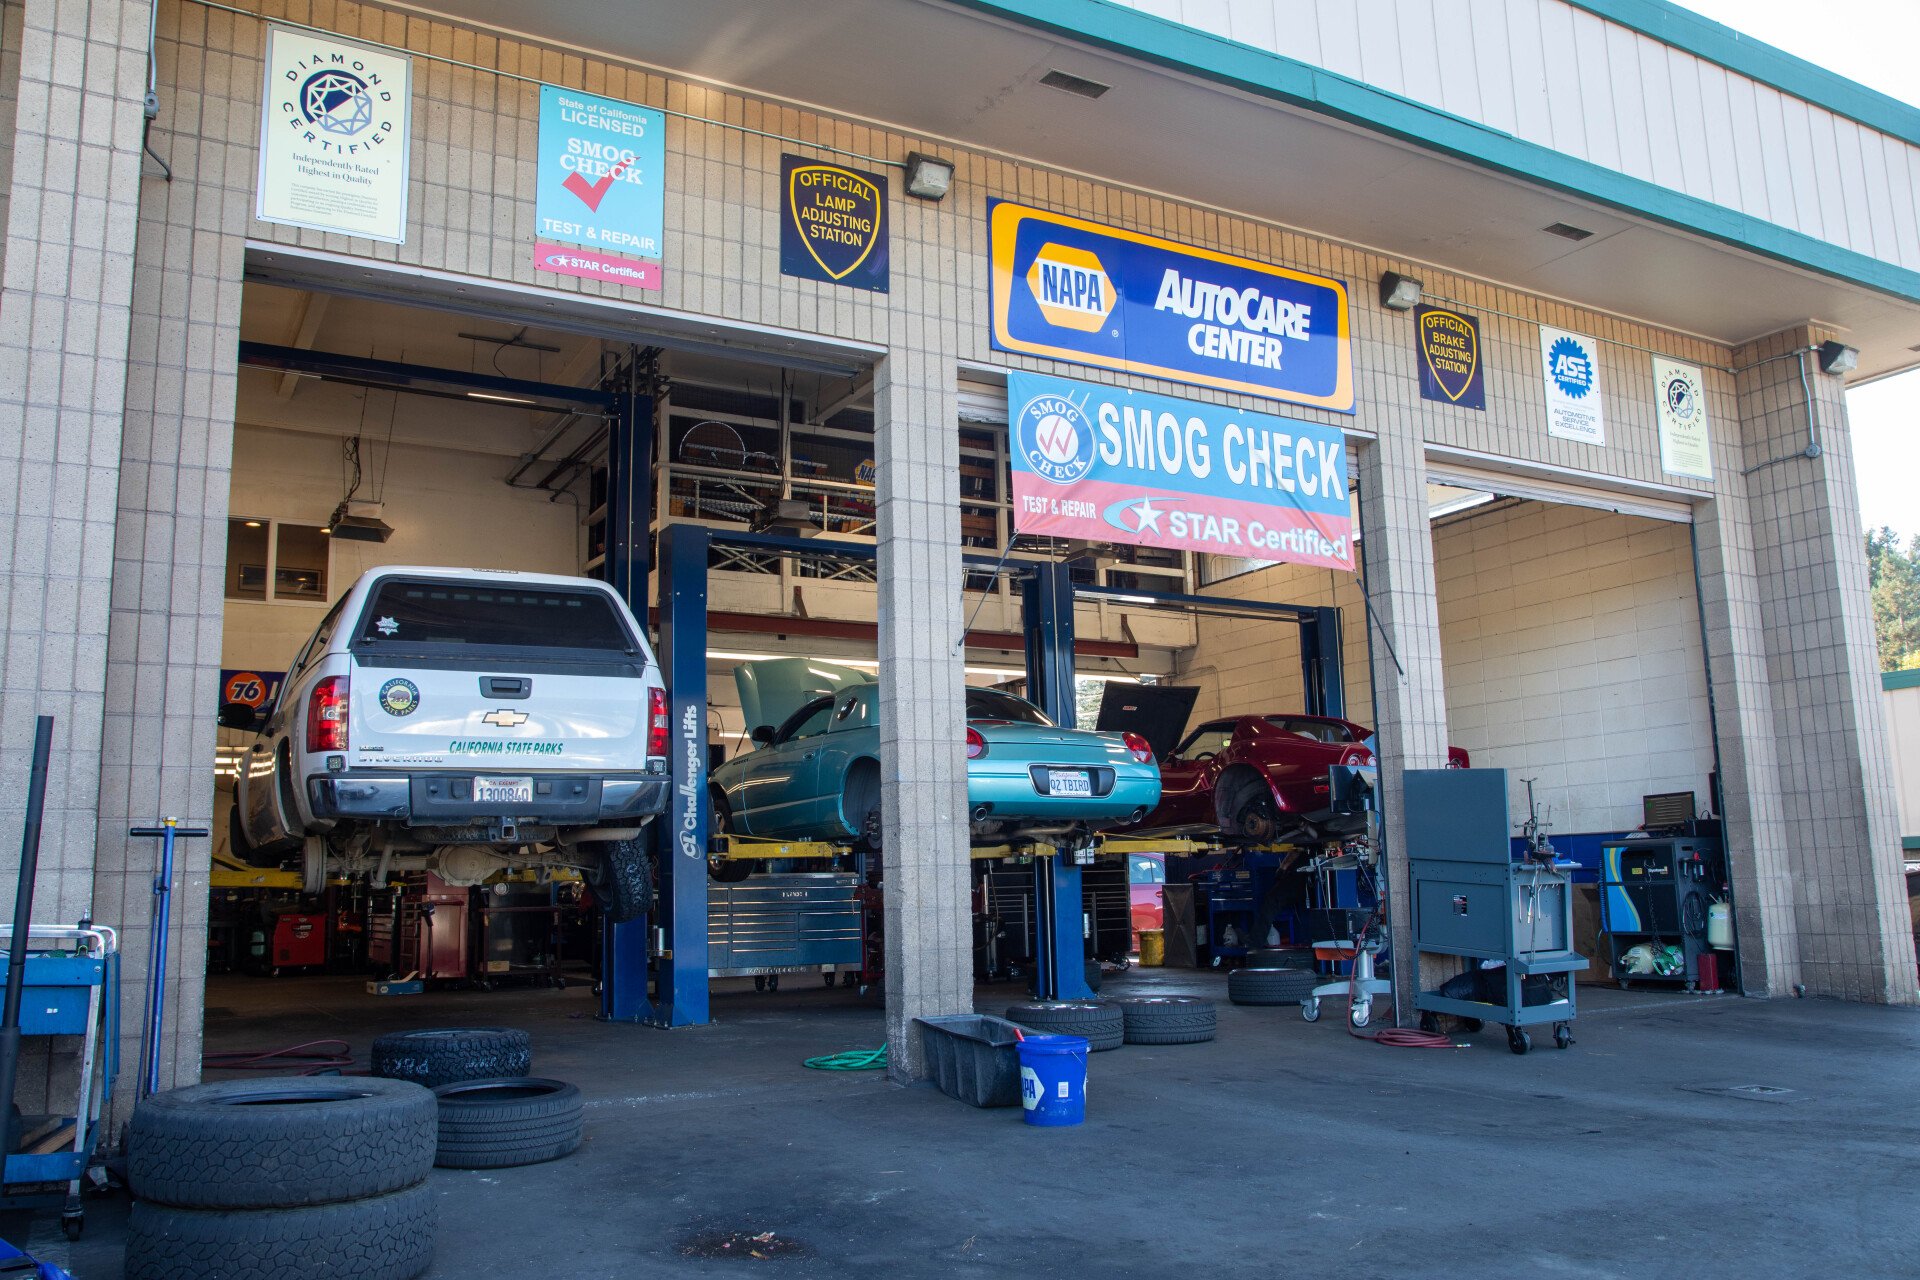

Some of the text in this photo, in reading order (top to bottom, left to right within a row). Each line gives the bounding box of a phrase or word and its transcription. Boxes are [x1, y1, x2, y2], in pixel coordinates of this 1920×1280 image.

[286, 53, 392, 102] DIAMOND
[558, 97, 648, 124] State of California
[283, 101, 392, 155] CERTIFIED
[561, 108, 644, 138] LICENSED
[567, 137, 637, 166] SMOG
[292, 152, 379, 176] Independently Rated
[298, 165, 373, 186] Highest in Quality
[559, 153, 643, 185] CHECK
[800, 172, 871, 201] OFFICIAL
[816, 192, 856, 212] LAMP
[801, 206, 871, 233] ADJUSTING
[543, 218, 655, 251] TEST & REPAIR
[810, 224, 862, 247] STATION
[571, 258, 645, 280] STAR Certified
[1042, 263, 1102, 312] NAPA
[1426, 317, 1470, 338] OFFICIAL
[1187, 323, 1283, 371] CENTER
[1432, 331, 1466, 349] BRAKE
[1429, 343, 1472, 363] ADJUSTING
[1435, 358, 1468, 374] STATION
[1554, 353, 1587, 380] ASE
[1557, 374, 1587, 386] CERTIFIED
[1661, 368, 1699, 397] DIAMOND
[1030, 400, 1079, 422] SMOG
[1553, 408, 1596, 423] AUTOMOTIVE
[1562, 415, 1589, 427] SERVICE
[1662, 400, 1702, 431] CERTIFIED
[1555, 420, 1597, 434] EXCELLENCE
[1098, 402, 1345, 501] SMOG CHECK
[1029, 450, 1087, 479] CHECK
[1022, 495, 1097, 519] TEST & REPAIR
[1169, 510, 1347, 561] STAR Certified
[231, 681, 261, 701] 76
[382, 680, 418, 695] CALIFORNIA
[381, 698, 418, 716] STATE PARKS
[682, 704, 697, 738] Lifts
[449, 740, 564, 756] CALIFORNIA STATE PARKS
[679, 740, 701, 830] Challenger
[1062, 779, 1090, 792] TBIRD
[1021, 1077, 1036, 1099] PA
